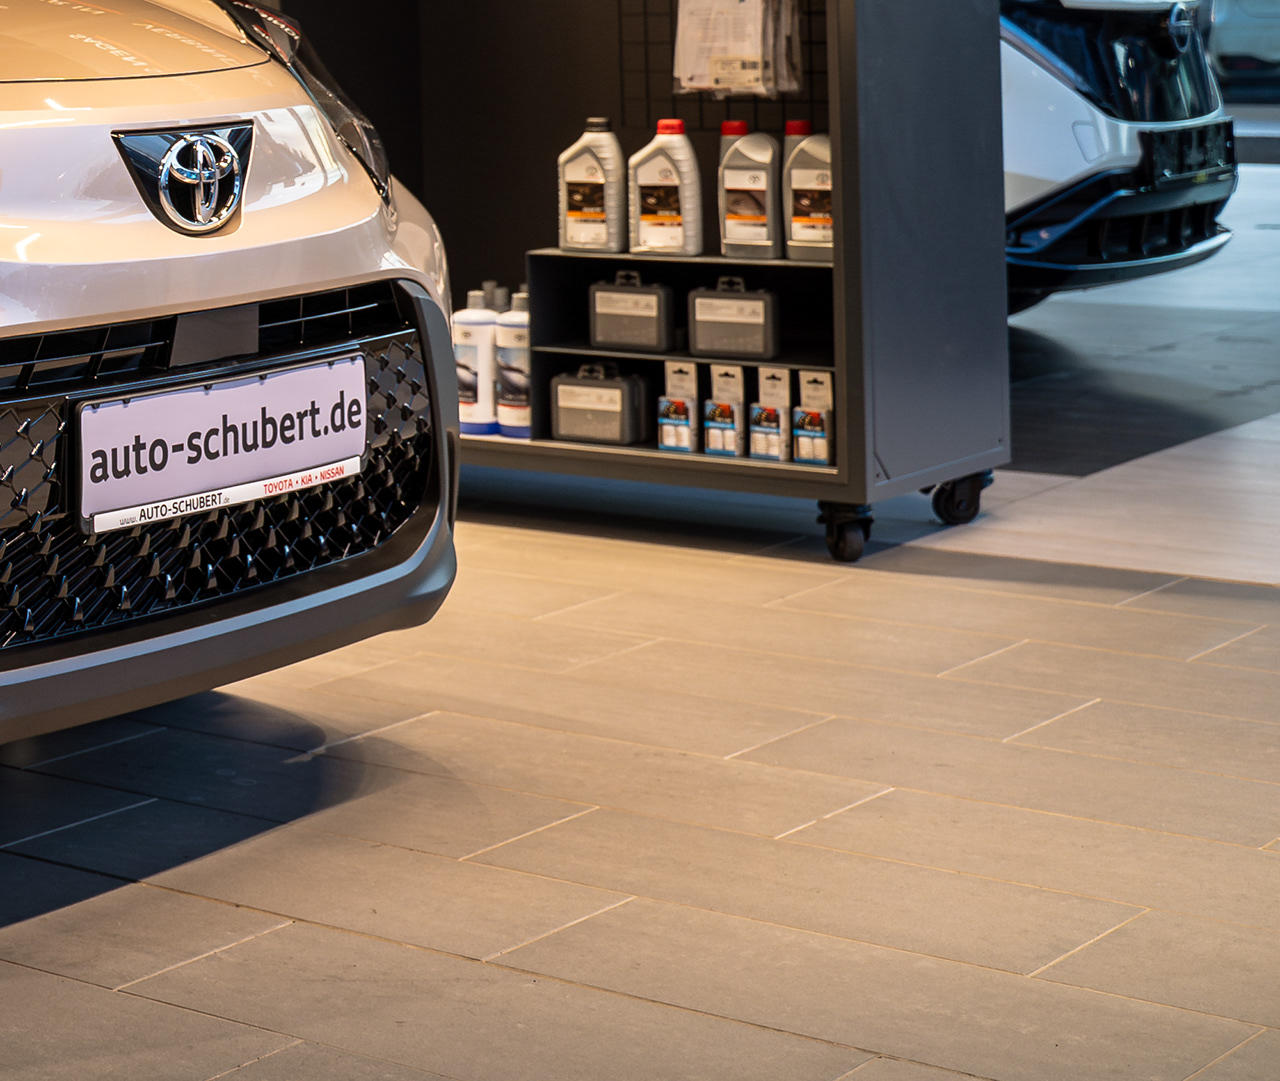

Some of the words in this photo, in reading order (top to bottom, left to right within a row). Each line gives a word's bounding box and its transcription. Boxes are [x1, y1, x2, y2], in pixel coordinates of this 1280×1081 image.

[89, 389, 362, 484] auto-schubert.de
[263, 478, 294, 495] TOYOTA
[300, 473, 313, 486] KIA
[320, 464, 345, 480] NISSAN
